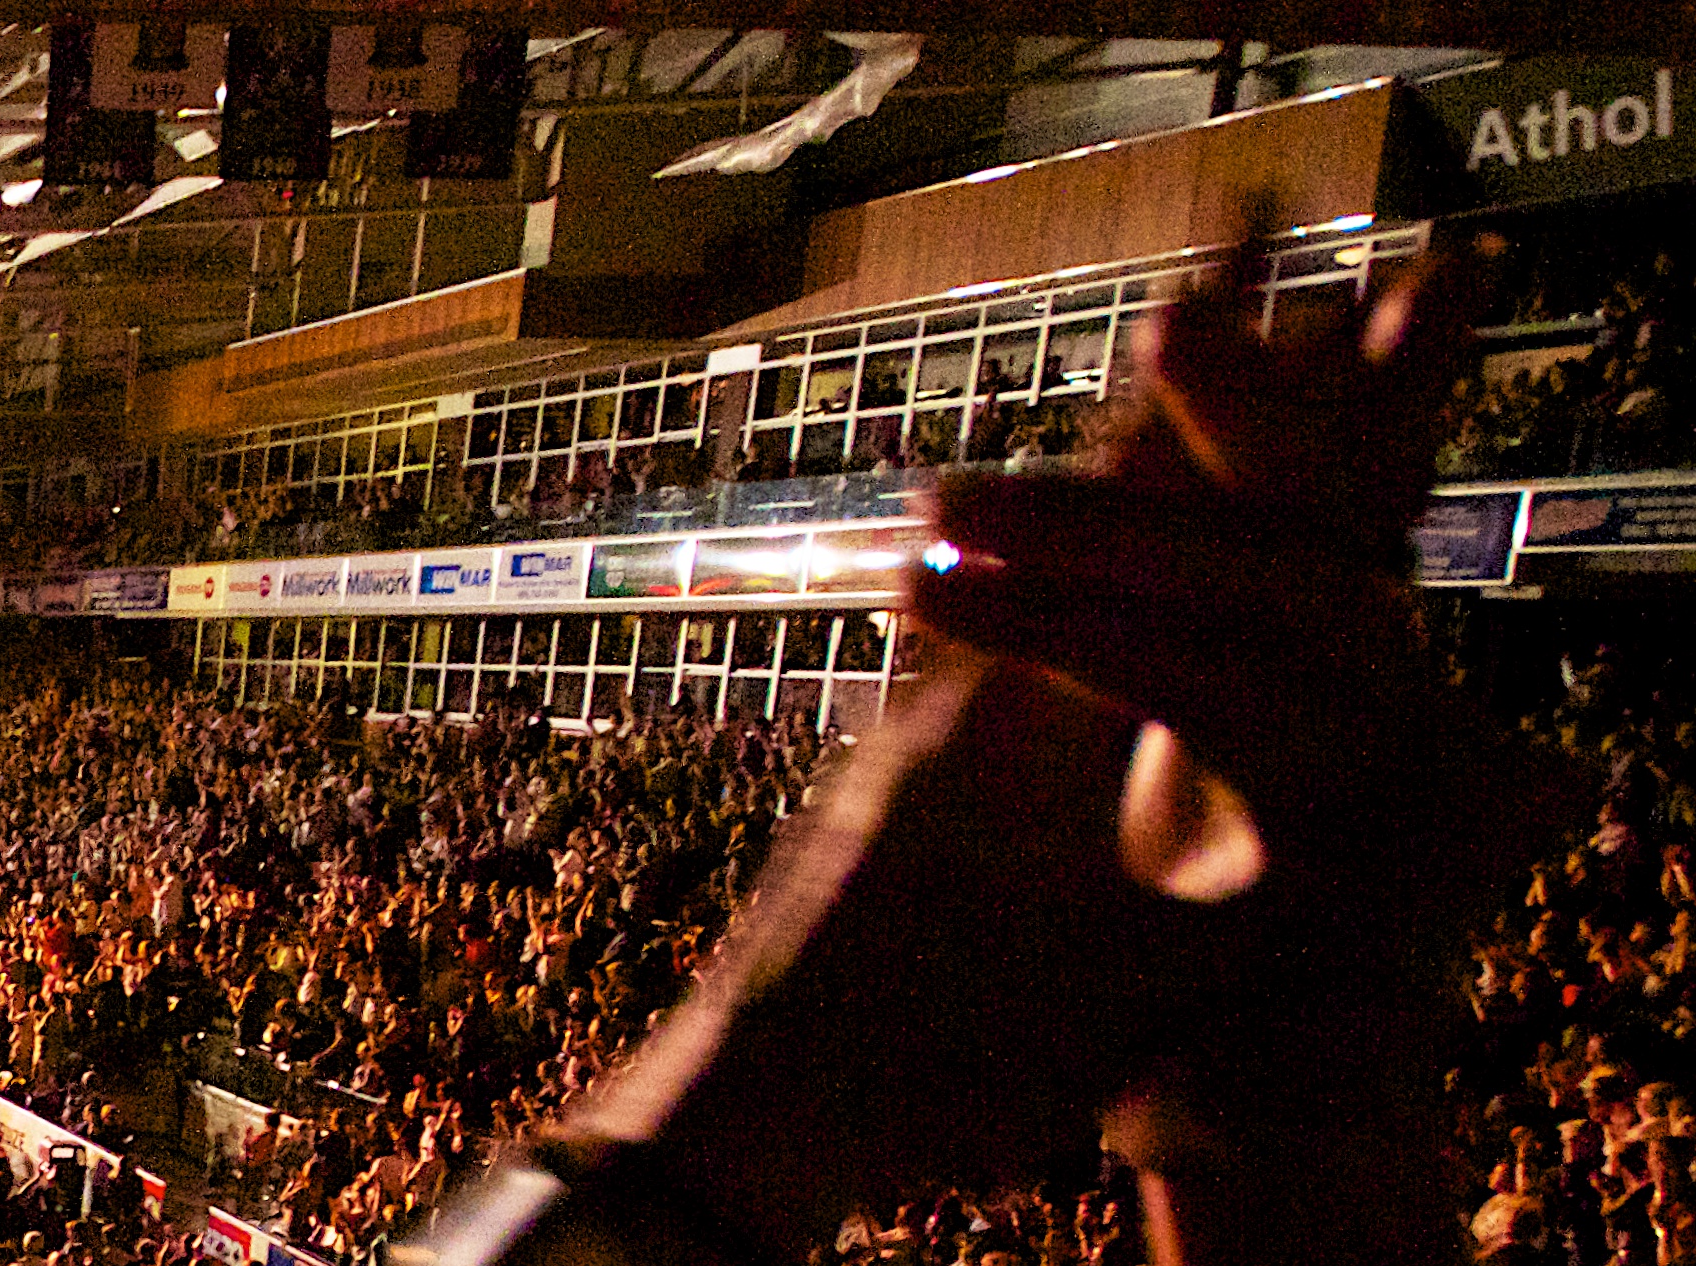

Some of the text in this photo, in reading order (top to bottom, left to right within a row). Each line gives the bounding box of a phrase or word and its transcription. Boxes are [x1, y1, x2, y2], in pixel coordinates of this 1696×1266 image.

[1467, 68, 1673, 171] Athol
[282, 574, 339, 597] Millwork
[346, 574, 412, 597] Millwork
